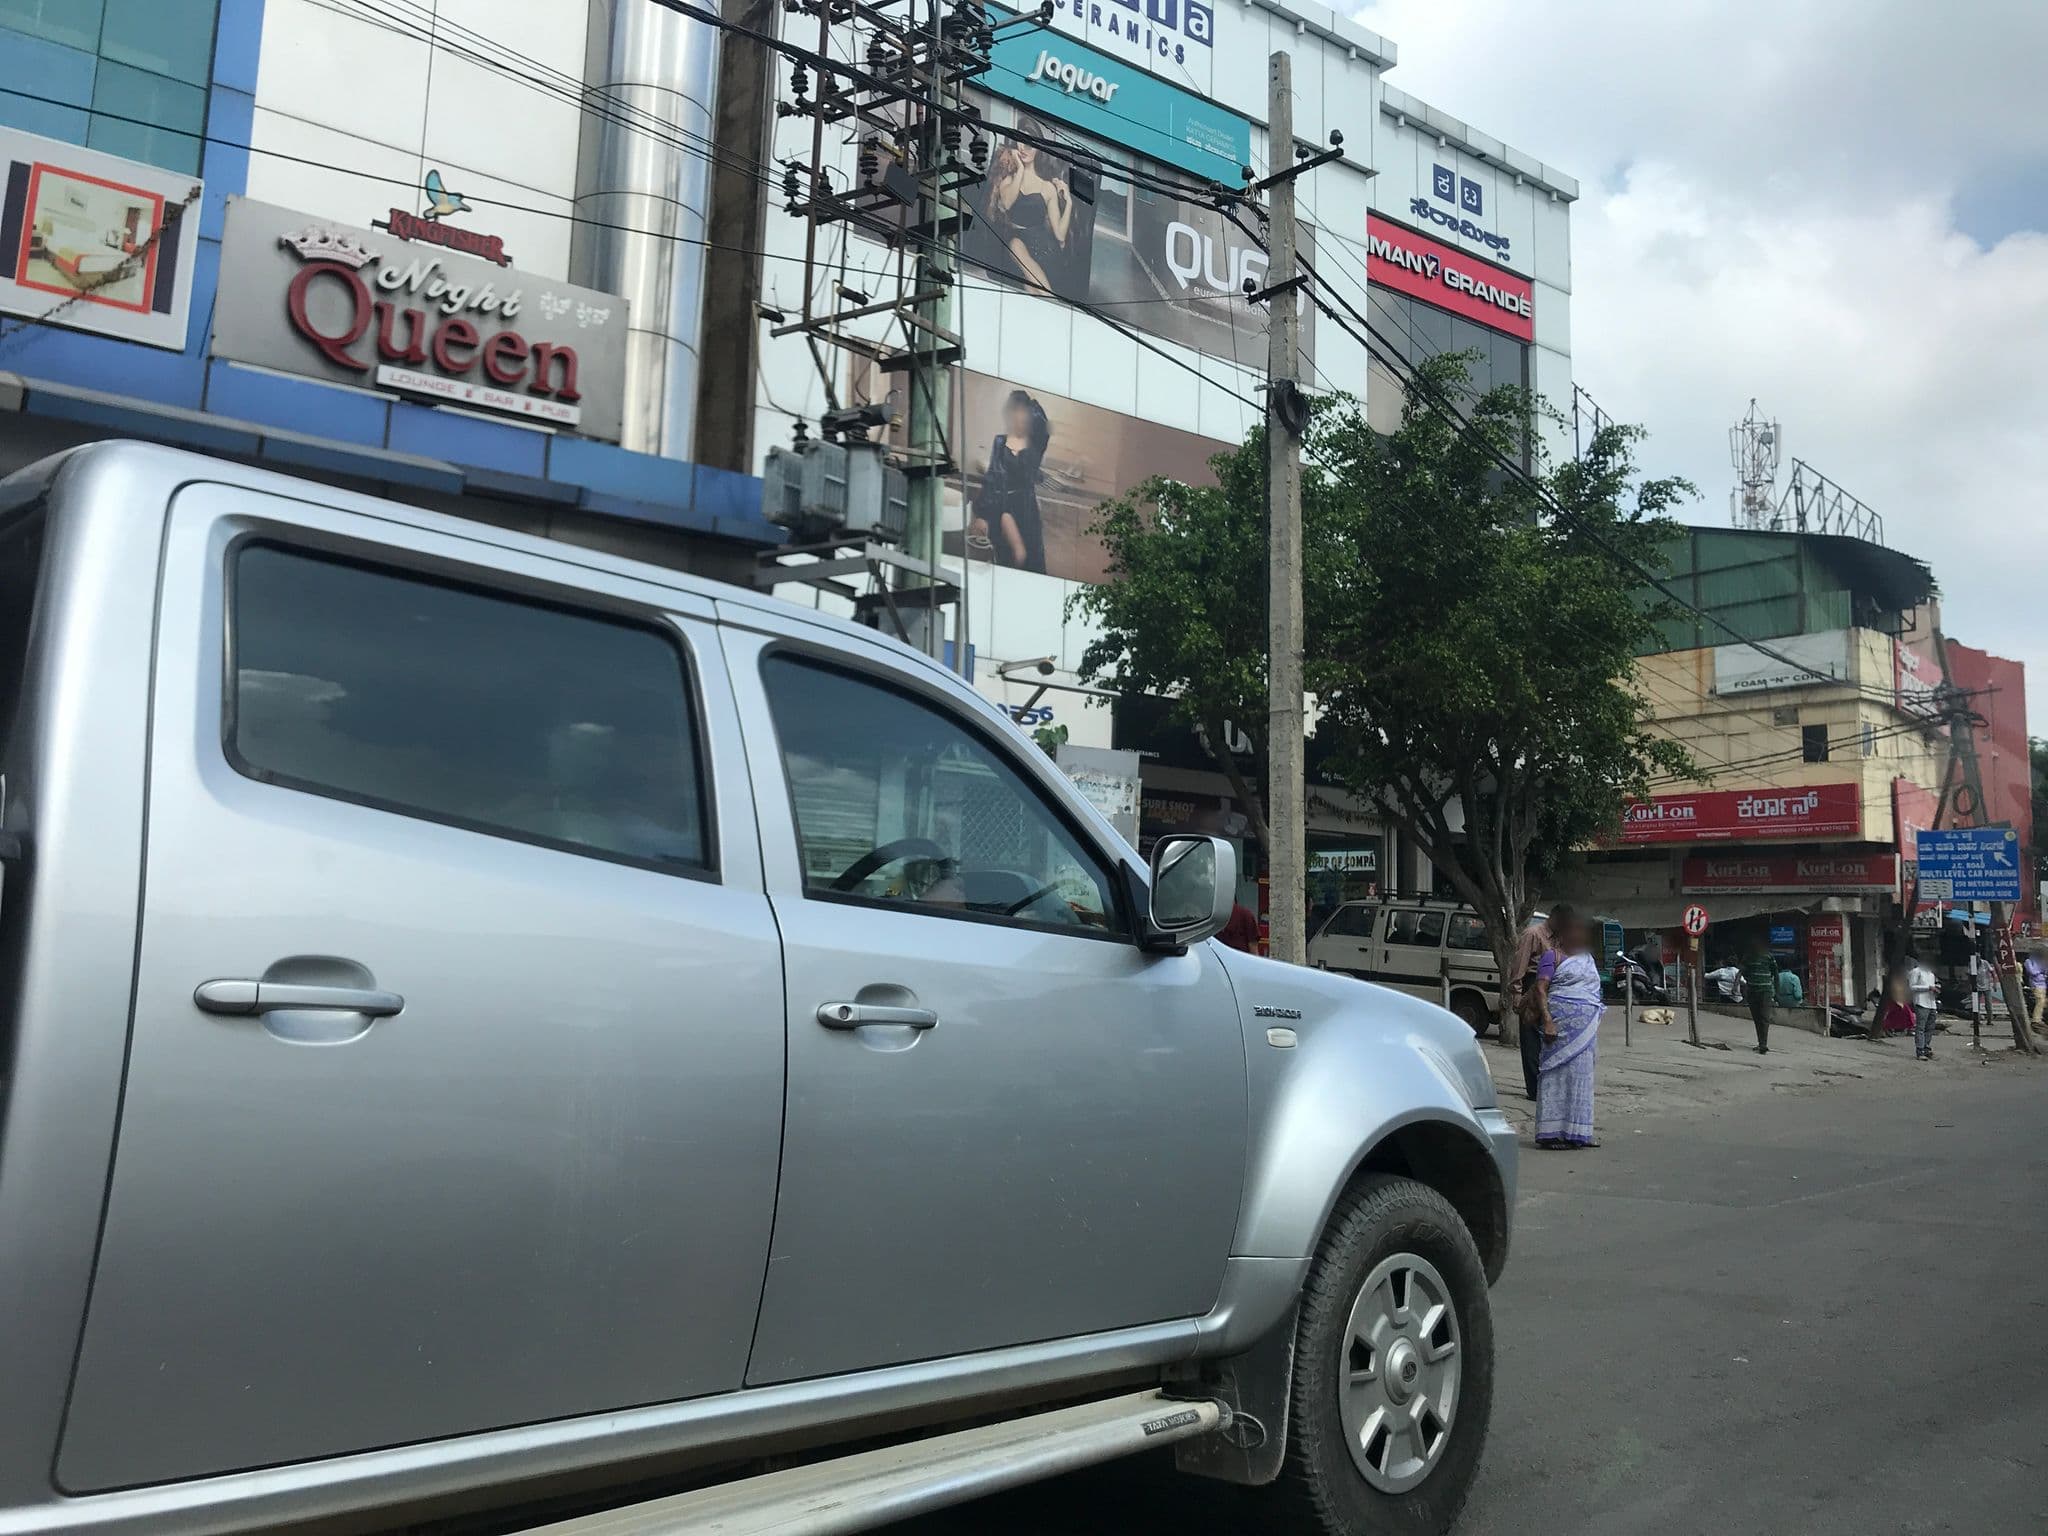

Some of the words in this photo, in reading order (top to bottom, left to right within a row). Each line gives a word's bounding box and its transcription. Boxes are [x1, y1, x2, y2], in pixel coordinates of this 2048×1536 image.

[1026, 50, 1120, 102] Jaquar
[388, 207, 508, 267] KINGFISHER
[1367, 234, 1438, 279] MANY
[376, 256, 522, 319] Night
[1165, 221, 1305, 317] QUE
[288, 261, 582, 401] Queen
[390, 371, 457, 394] LOUNGE
[484, 391, 514, 407] BAR
[541, 404, 571, 418] PUB
[1734, 678, 1767, 689] FOAM
[1706, 861, 1769, 878] Kurl-on
[1796, 860, 1866, 877] Kurl-on
[1920, 870, 1942, 879] MULTI
[1944, 870, 1966, 878] LEVEL
[1967, 870, 1983, 878] CAR
[1984, 869, 2017, 878] PARKING
[1147, 1419, 1169, 1432] TATA
